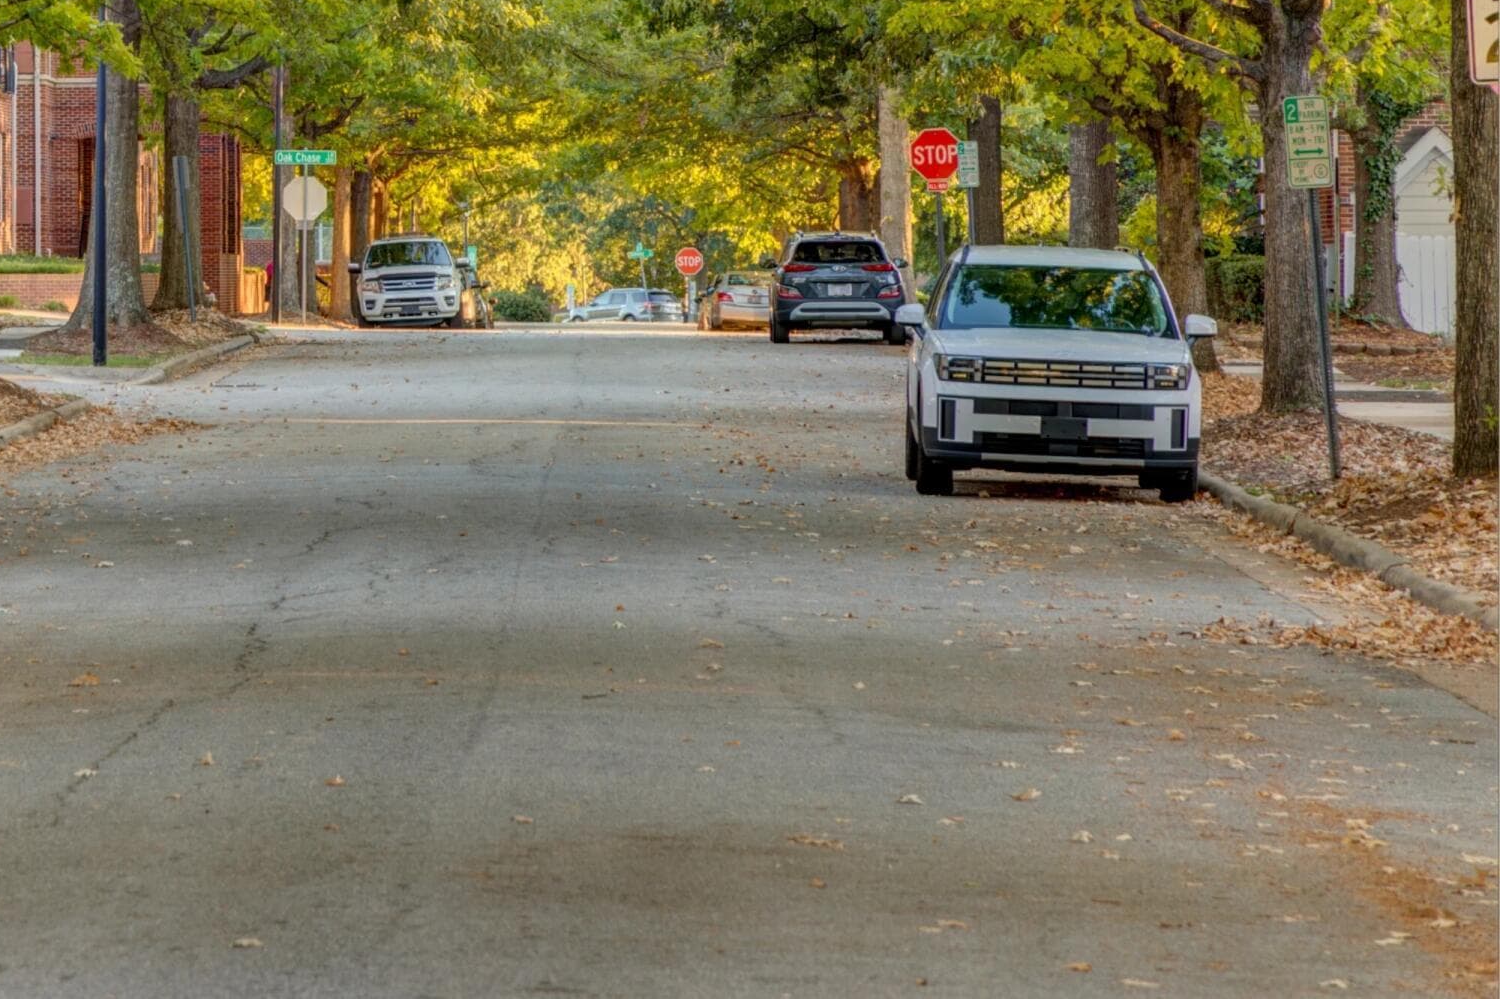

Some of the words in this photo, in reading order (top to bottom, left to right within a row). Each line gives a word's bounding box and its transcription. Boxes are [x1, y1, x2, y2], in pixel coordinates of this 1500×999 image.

[1286, 103, 1296, 120] 2
[277, 152, 292, 162] Oak
[296, 152, 320, 162] Chase
[914, 144, 958, 165] STOP
[677, 255, 700, 267] STOP
